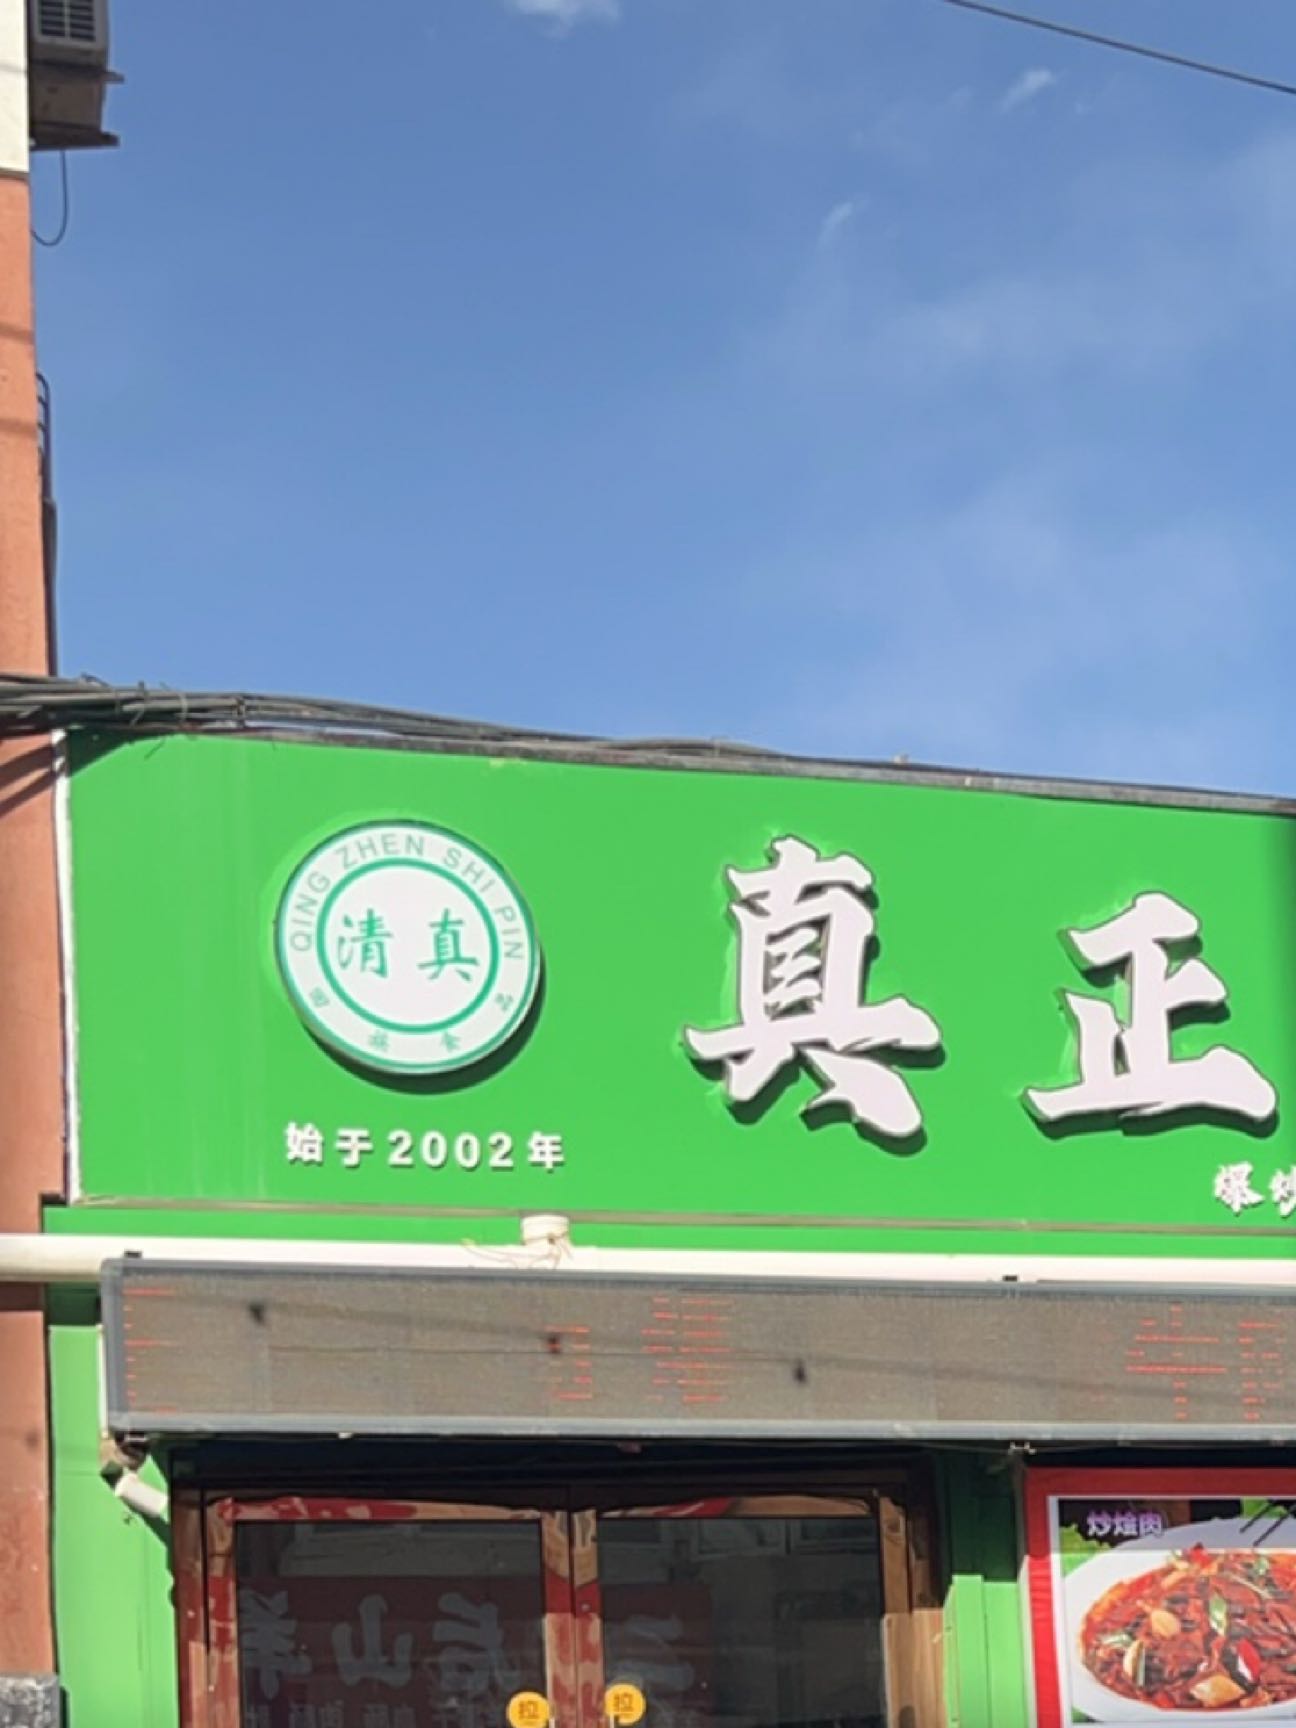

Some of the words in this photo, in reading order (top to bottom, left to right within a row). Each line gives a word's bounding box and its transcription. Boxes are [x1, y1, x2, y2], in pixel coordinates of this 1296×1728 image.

[290, 870, 331, 952] QING
[335, 833, 426, 870] ZHEN
[443, 847, 497, 894] SHI
[494, 904, 525, 961] PIN
[337, 907, 481, 982] 清真
